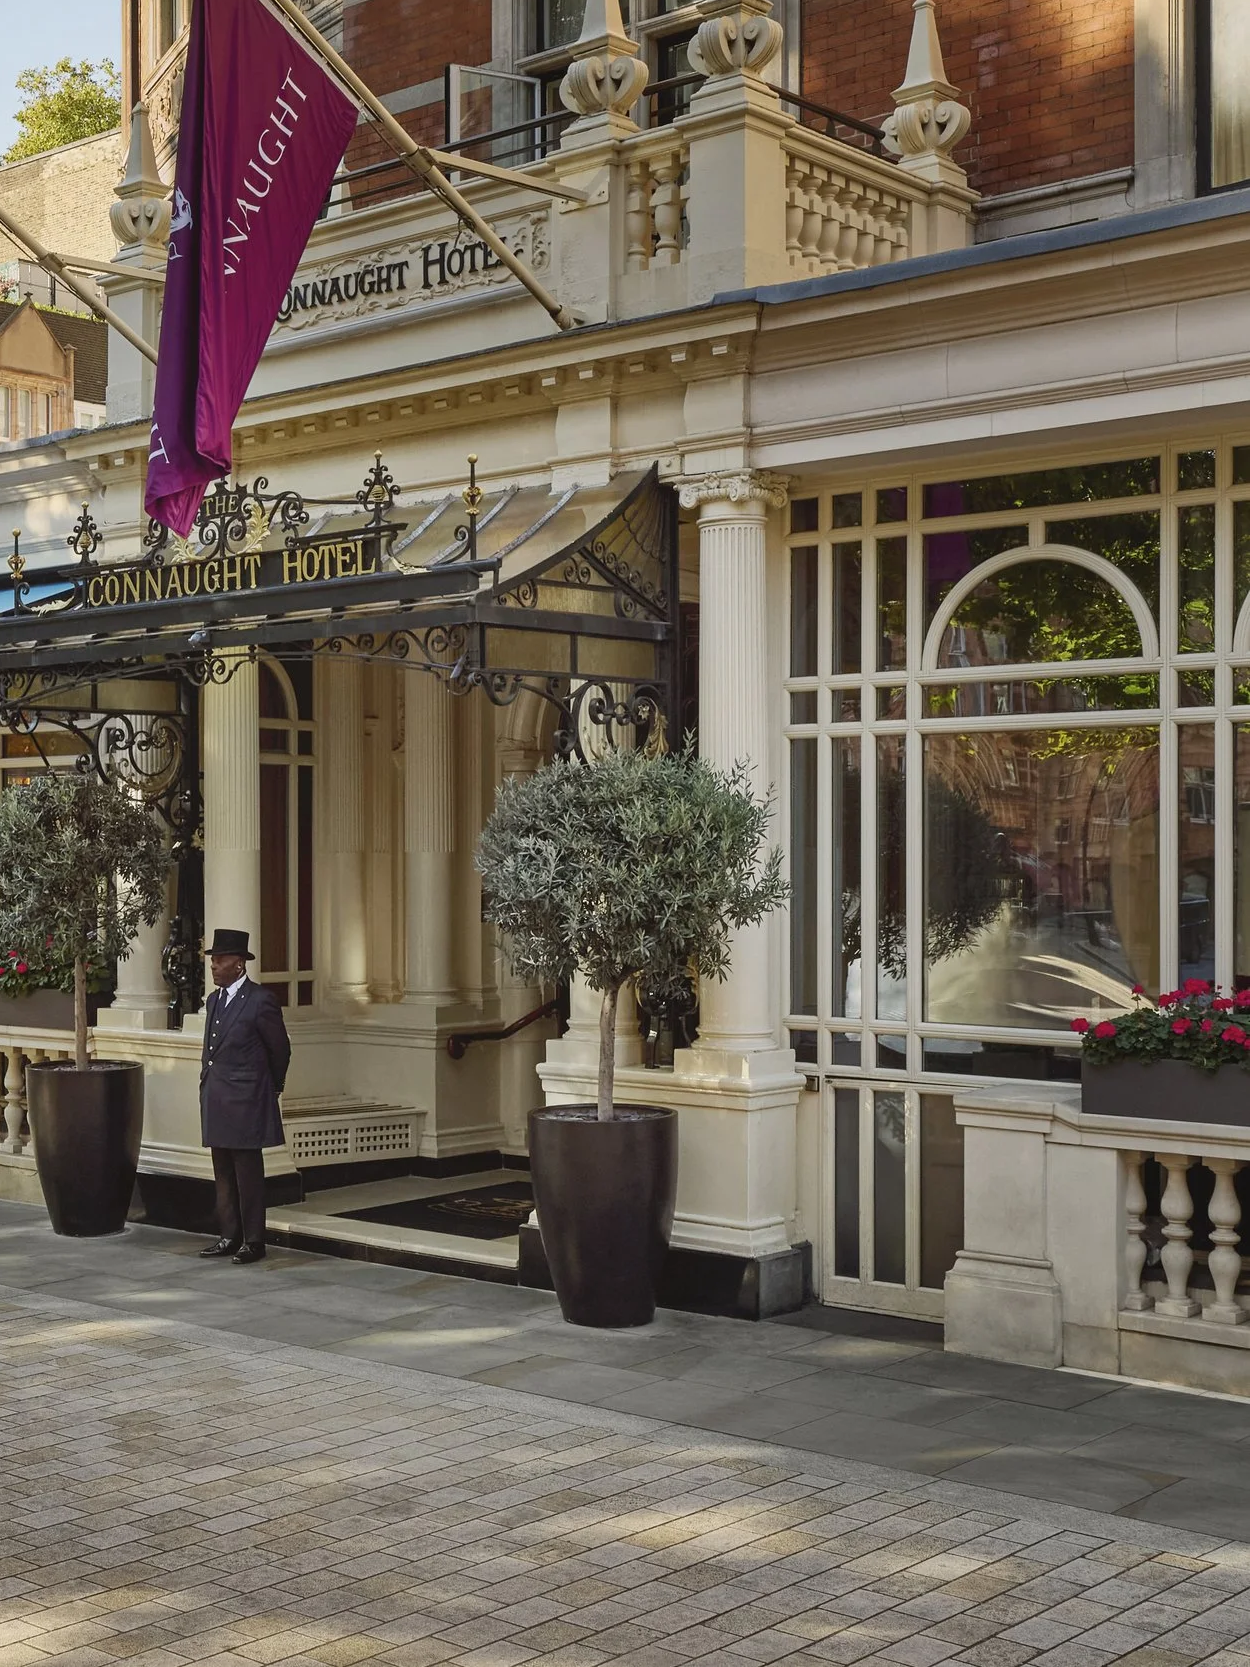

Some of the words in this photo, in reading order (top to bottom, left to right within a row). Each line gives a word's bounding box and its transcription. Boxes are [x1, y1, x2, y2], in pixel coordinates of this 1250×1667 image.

[277, 260, 410, 323] ONNAUGHT
[203, 493, 239, 517] THE
[88, 555, 262, 606] CONNAUGHT
[282, 540, 376, 584] HOTEL
